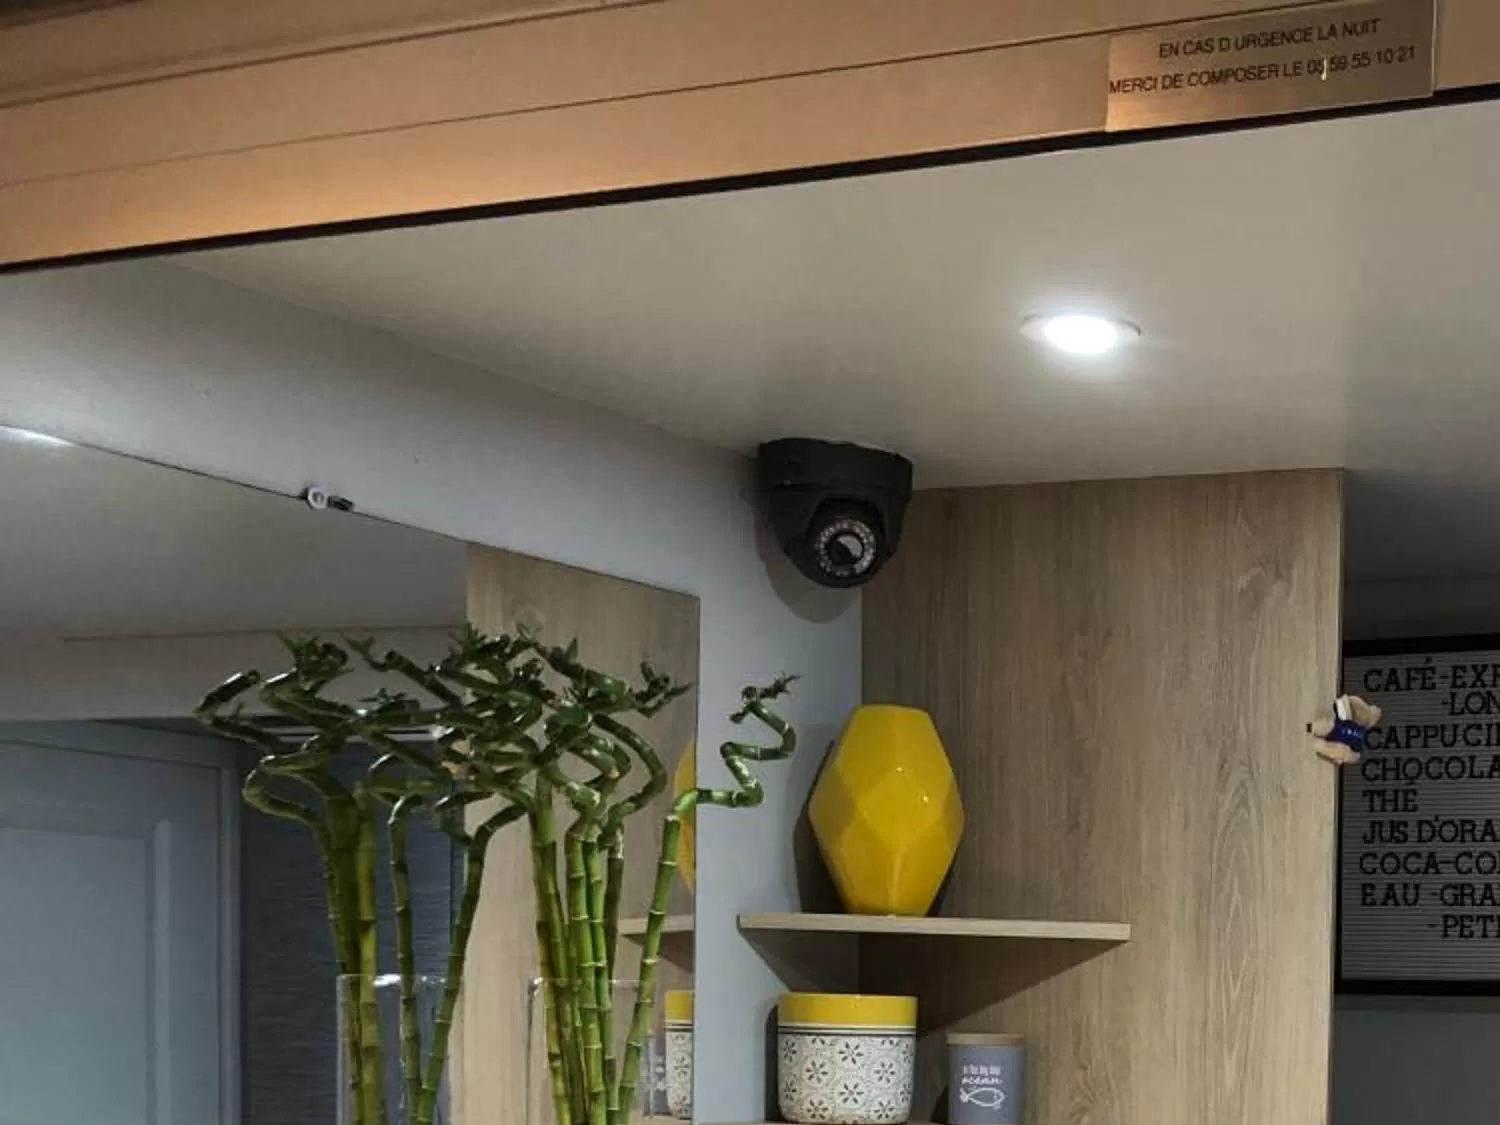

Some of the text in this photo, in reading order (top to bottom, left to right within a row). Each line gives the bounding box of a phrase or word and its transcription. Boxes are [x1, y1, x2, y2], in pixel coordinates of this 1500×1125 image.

[1159, 18, 1382, 59] EN CAS D URGENCE LA NUIT
[1109, 44, 1416, 95] MERCI DE COMPOSER LE 05 59 55 10 21
[1363, 819, 1409, 844] JUS
[1360, 883, 1421, 907] EAU
